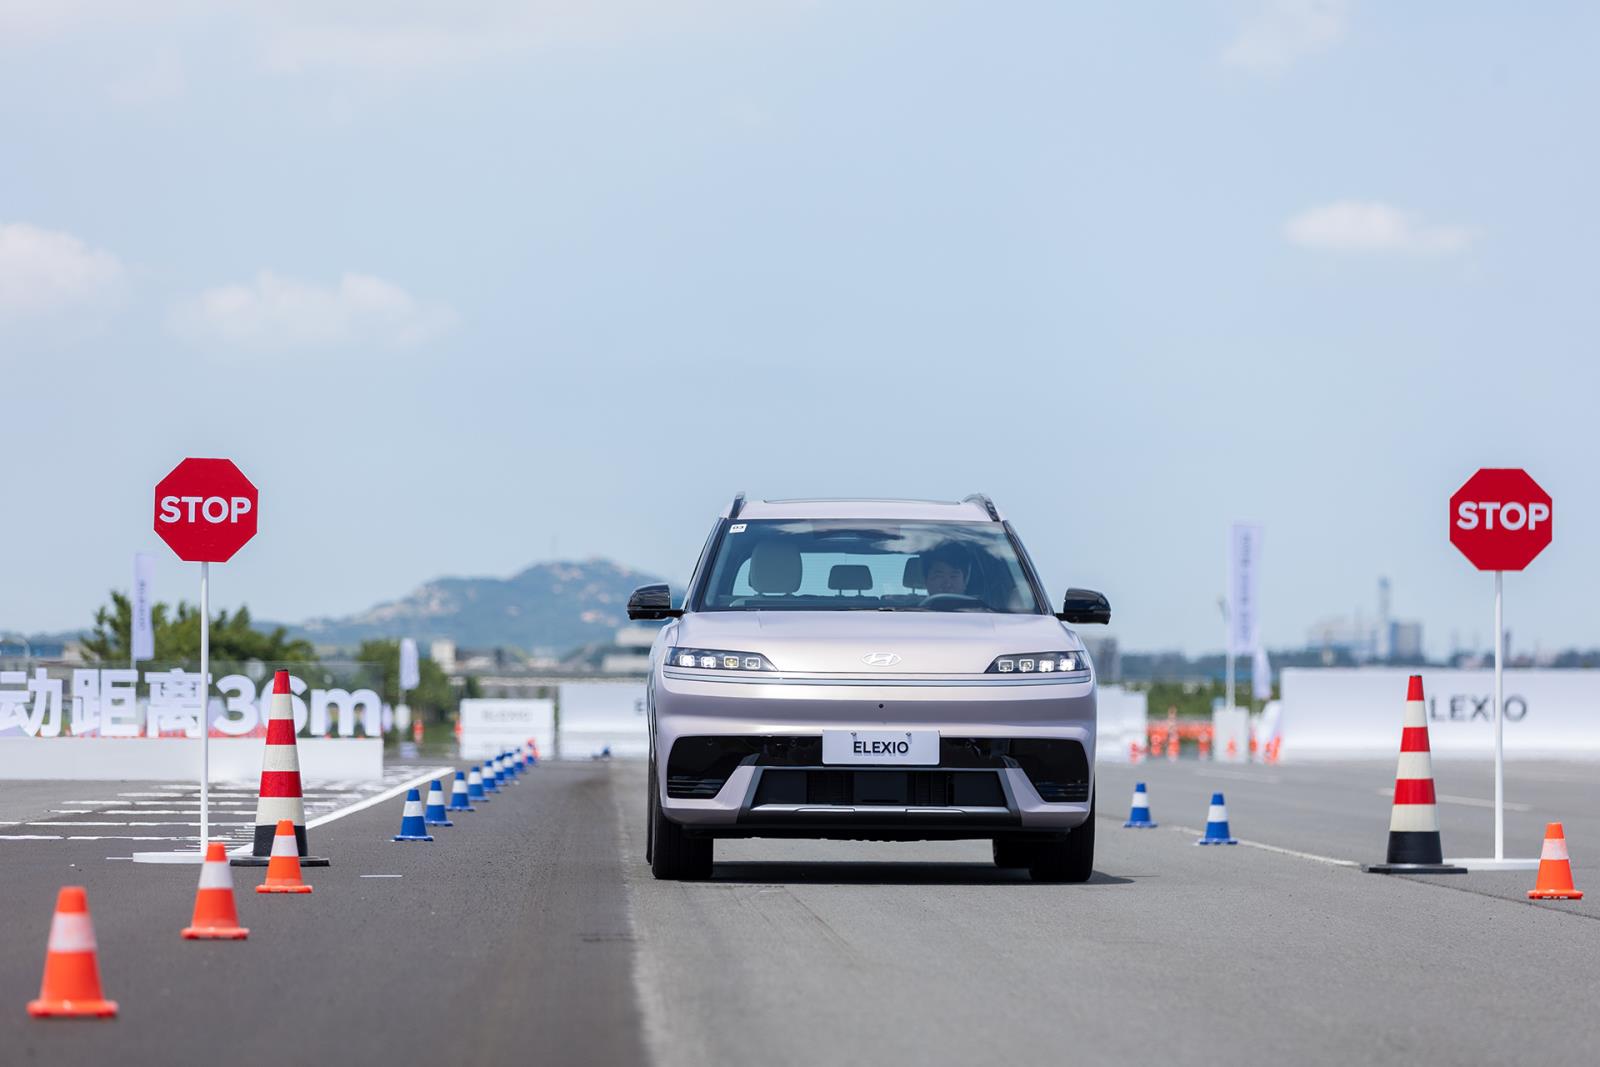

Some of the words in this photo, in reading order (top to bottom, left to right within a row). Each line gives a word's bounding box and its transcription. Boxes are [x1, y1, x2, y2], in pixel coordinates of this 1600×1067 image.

[159, 495, 252, 524] STOP
[1456, 501, 1550, 531] STOP
[853, 741, 909, 754] ELEXIO
